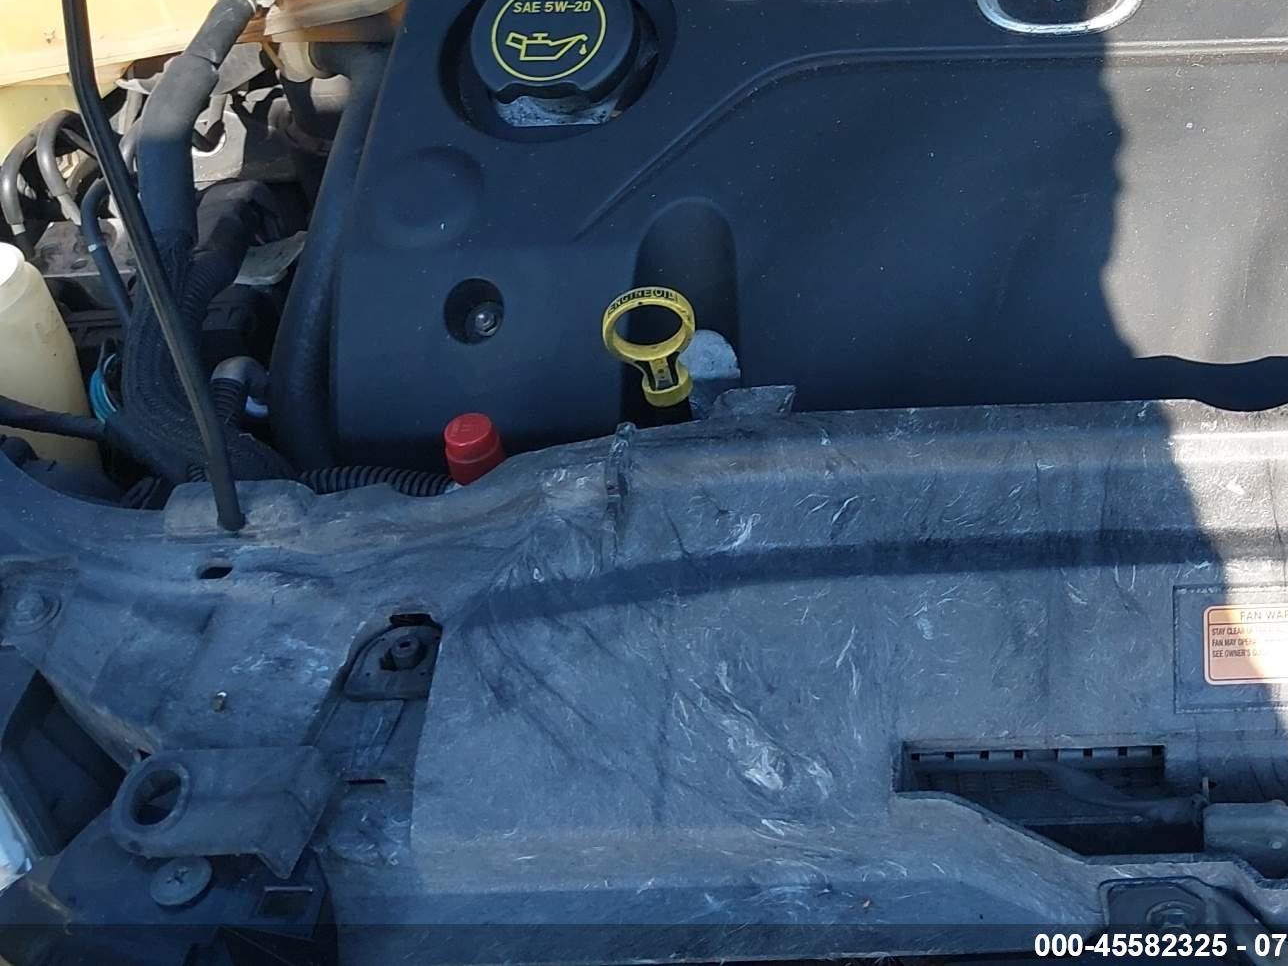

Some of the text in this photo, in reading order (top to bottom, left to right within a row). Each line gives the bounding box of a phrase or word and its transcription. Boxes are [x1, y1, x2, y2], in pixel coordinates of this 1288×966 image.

[512, 0, 592, 13] SAE 5W-20
[1240, 611, 1262, 621] FAN
